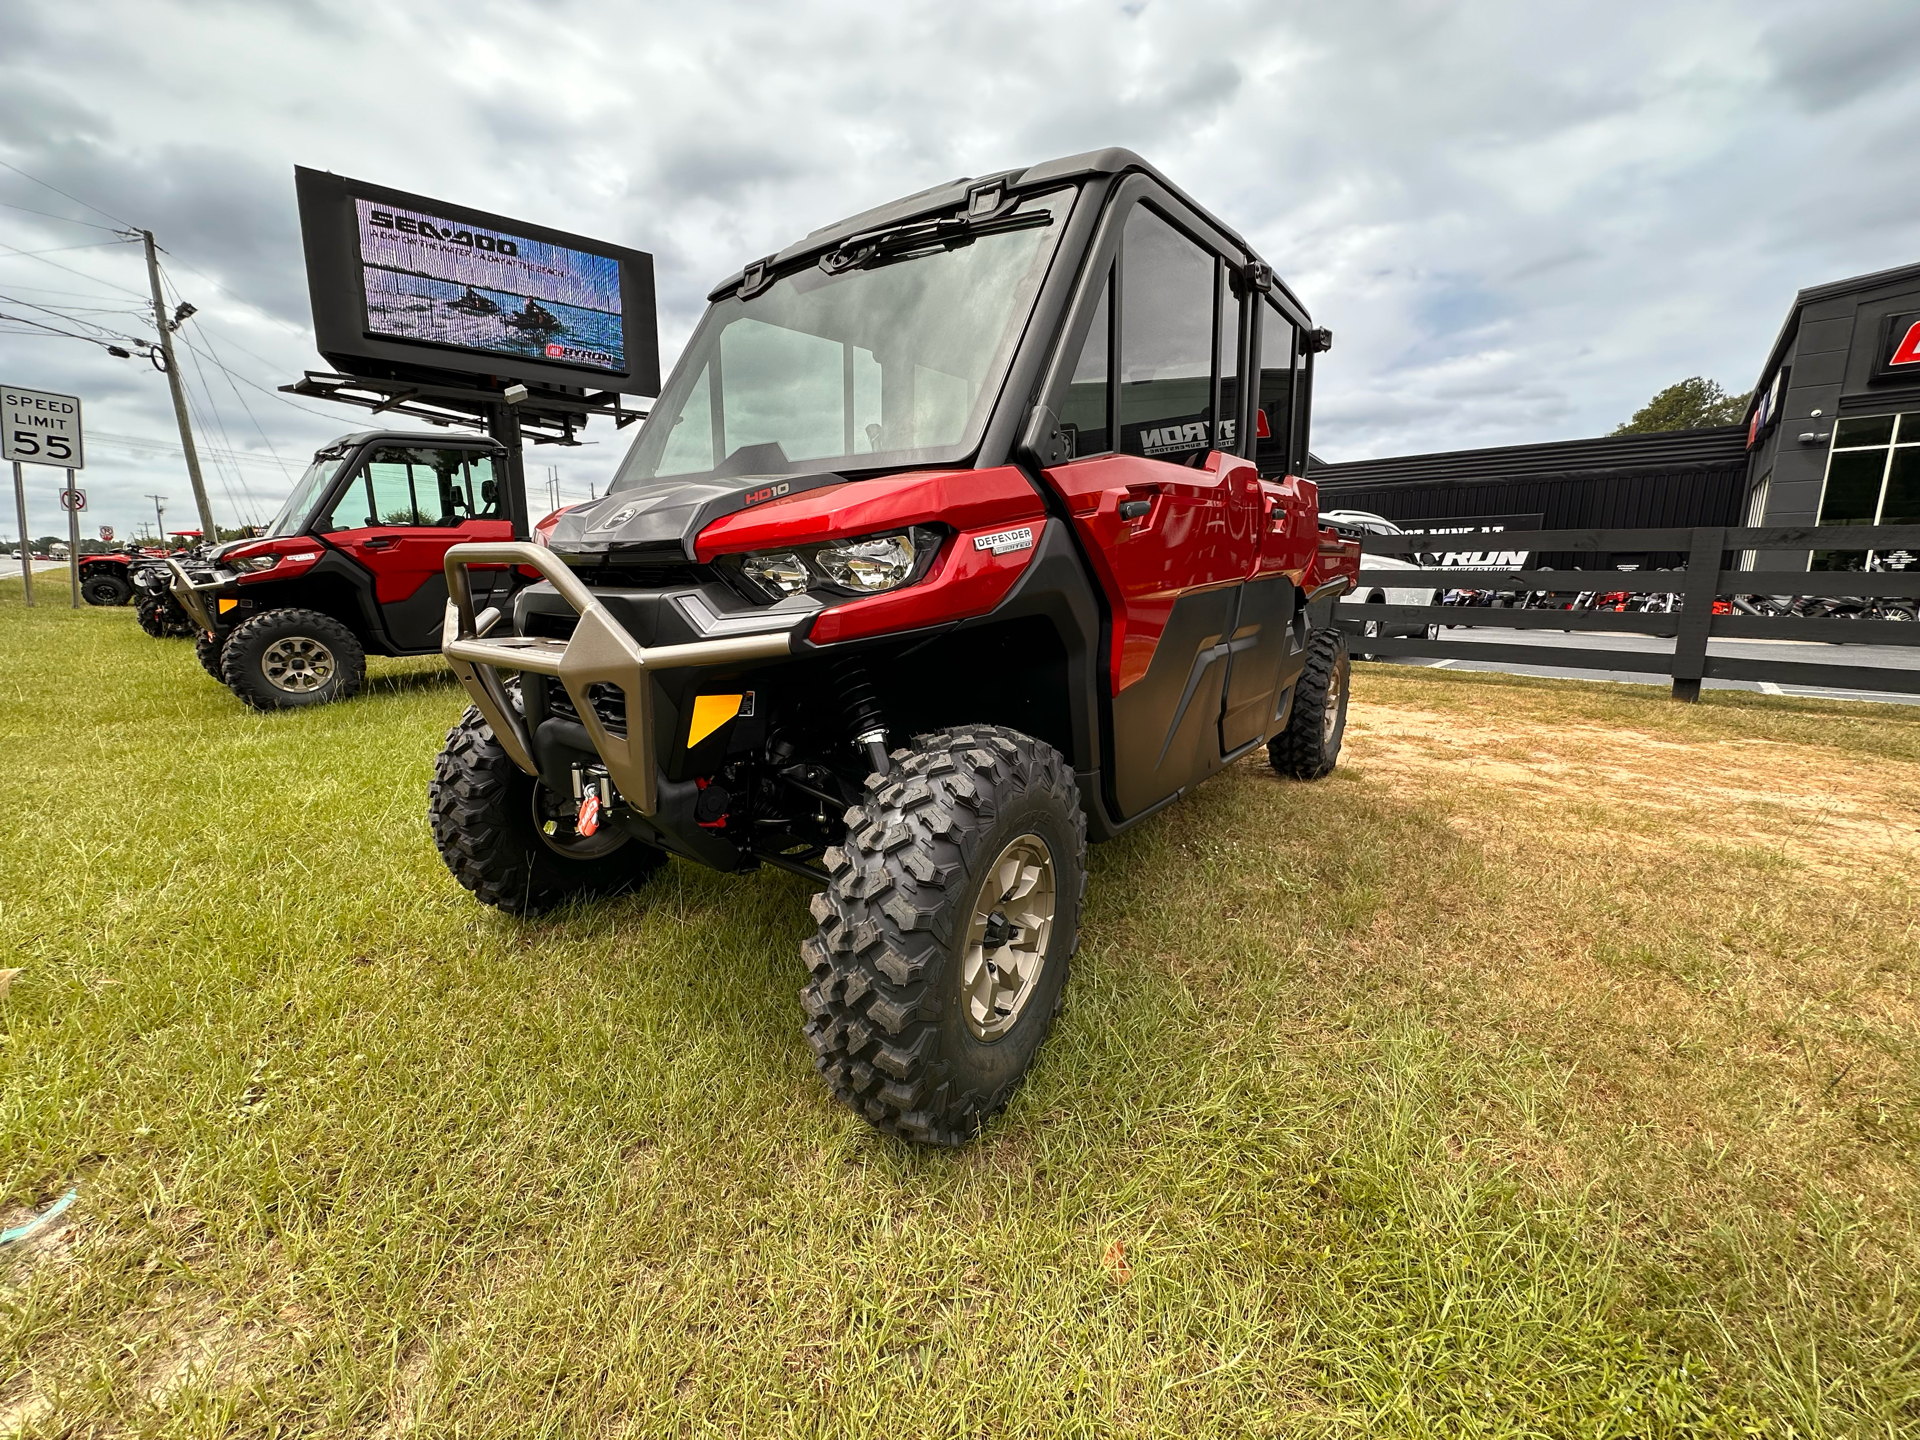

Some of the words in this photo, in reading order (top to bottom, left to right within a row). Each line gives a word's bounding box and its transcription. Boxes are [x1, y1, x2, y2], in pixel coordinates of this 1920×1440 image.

[439, 245, 472, 257] WATER
[563, 347, 613, 361] BYRON
[6, 394, 74, 414] SPEED
[14, 413, 67, 430] LIMIT
[14, 430, 72, 460] 55
[746, 483, 790, 504] HD10
[977, 529, 1031, 547] DEFENDER
